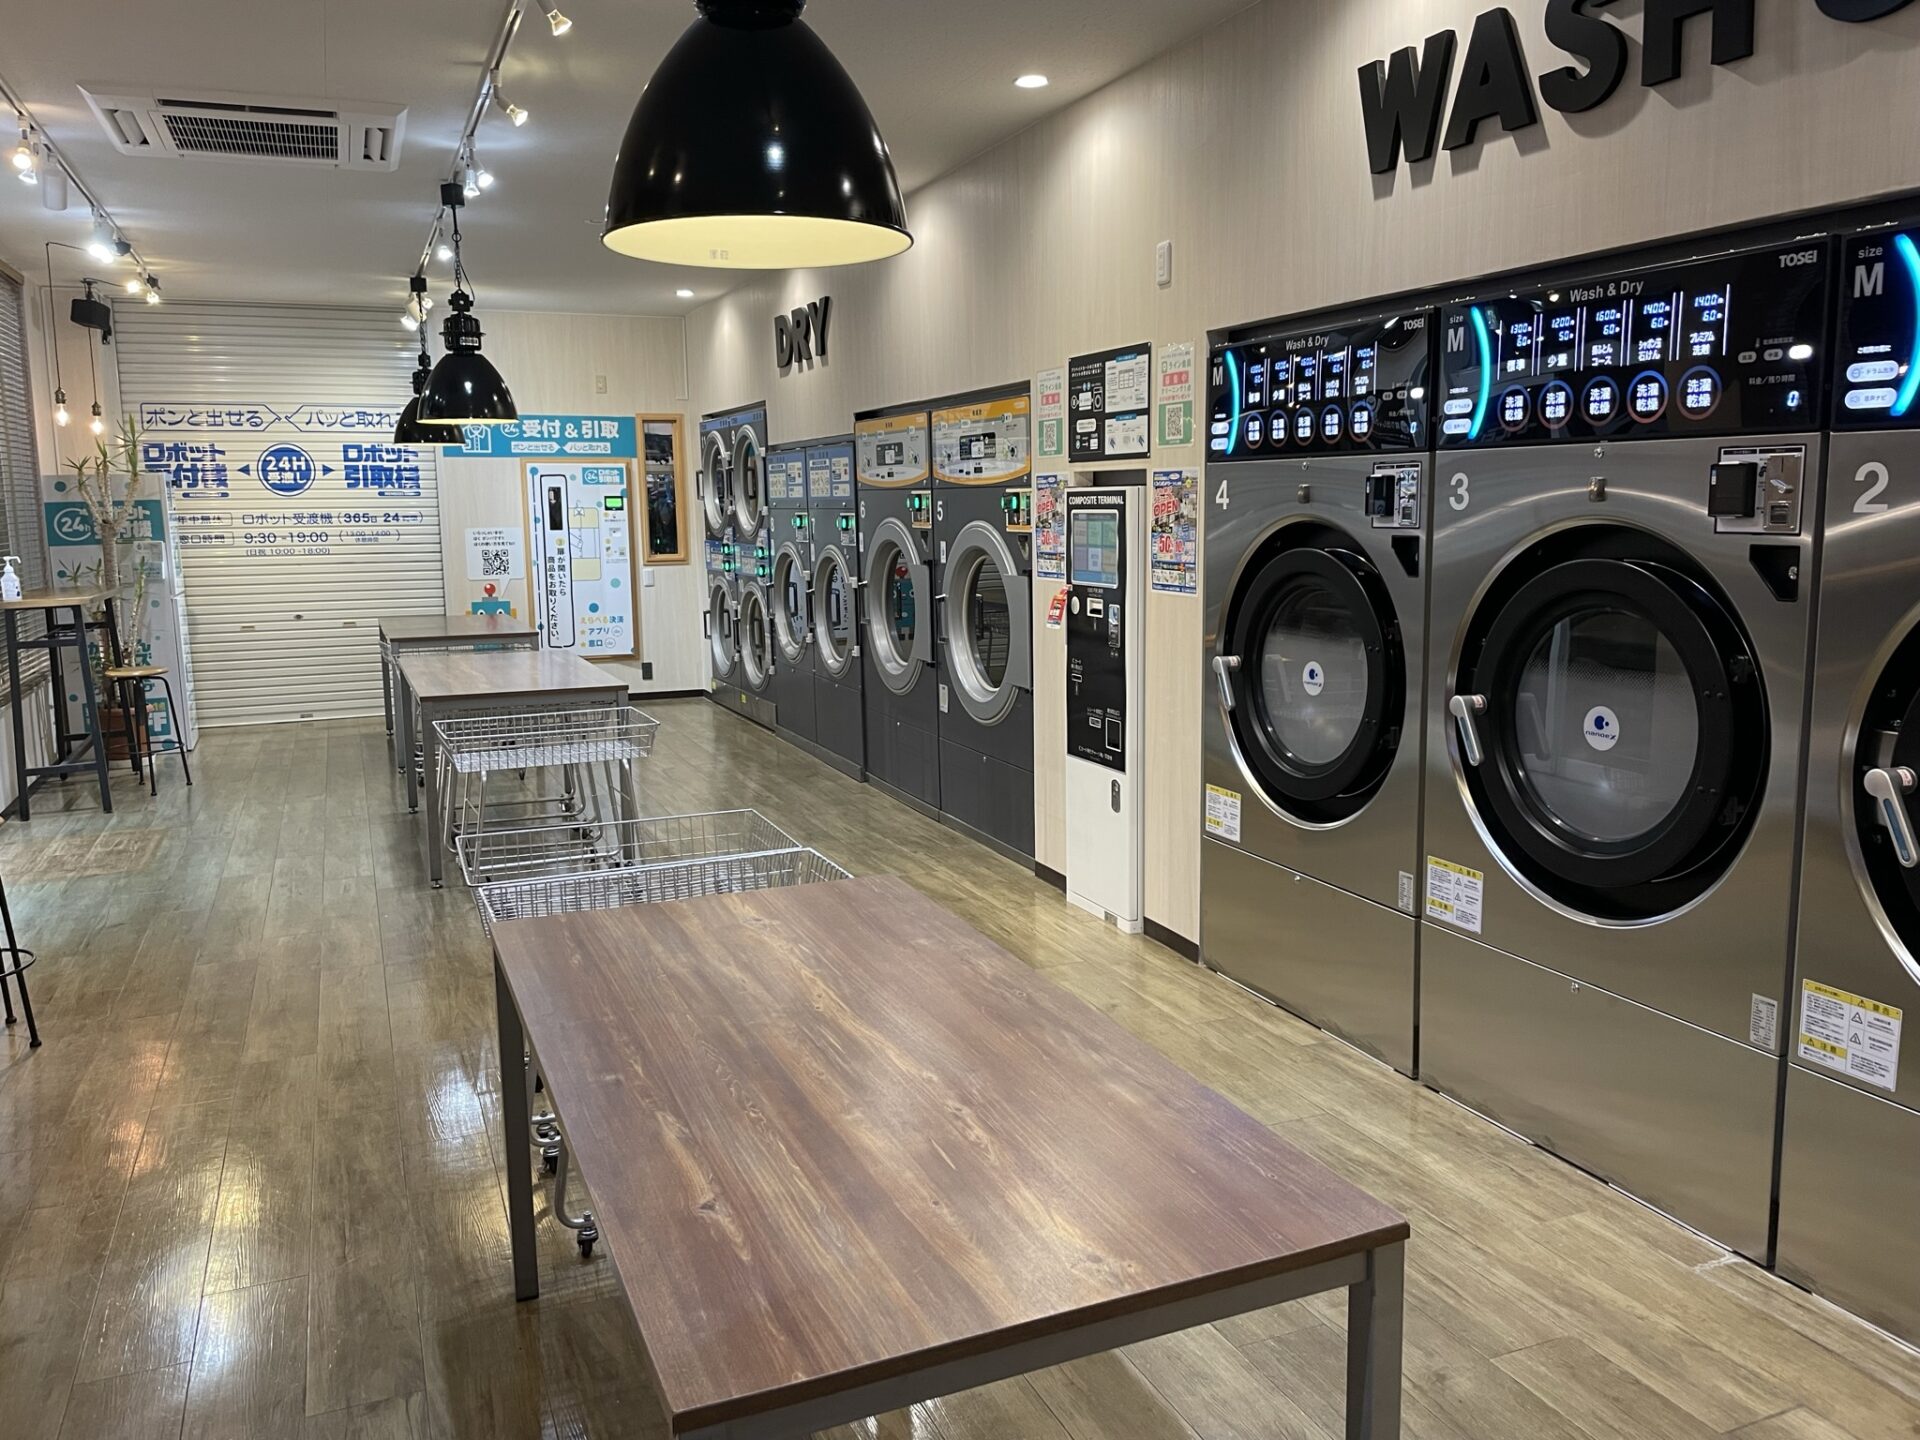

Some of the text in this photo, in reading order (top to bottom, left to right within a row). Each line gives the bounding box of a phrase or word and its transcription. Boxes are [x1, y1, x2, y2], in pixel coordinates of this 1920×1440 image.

[1779, 250, 1818, 268] TOSEI
[1857, 246, 1884, 258] size
[1853, 262, 1885, 298] M
[1570, 279, 1645, 302] Wash & Dry
[1403, 318, 1425, 331] TOSEI
[1449, 314, 1464, 324] size
[774, 296, 830, 368] DRY
[1447, 326, 1465, 353] M
[1286, 335, 1330, 351] Wash & Dry
[1213, 365, 1223, 386] M
[1787, 390, 1800, 407] 0
[146, 407, 264, 427] ポンと出せる
[522, 419, 561, 438] 受付
[581, 420, 620, 439] 引取
[143, 442, 226, 462] ロボット
[342, 444, 419, 463] ロボット
[265, 456, 306, 470] 24H
[1215, 479, 1230, 511] 4
[1449, 472, 1470, 511] 3
[1853, 461, 1889, 514] 2
[860, 500, 866, 518] 6
[1068, 495, 1124, 505] COMPOSITE TERMINAL
[1154, 501, 1179, 517] OPEN
[936, 501, 943, 521] 5
[588, 627, 610, 636] アプリ
